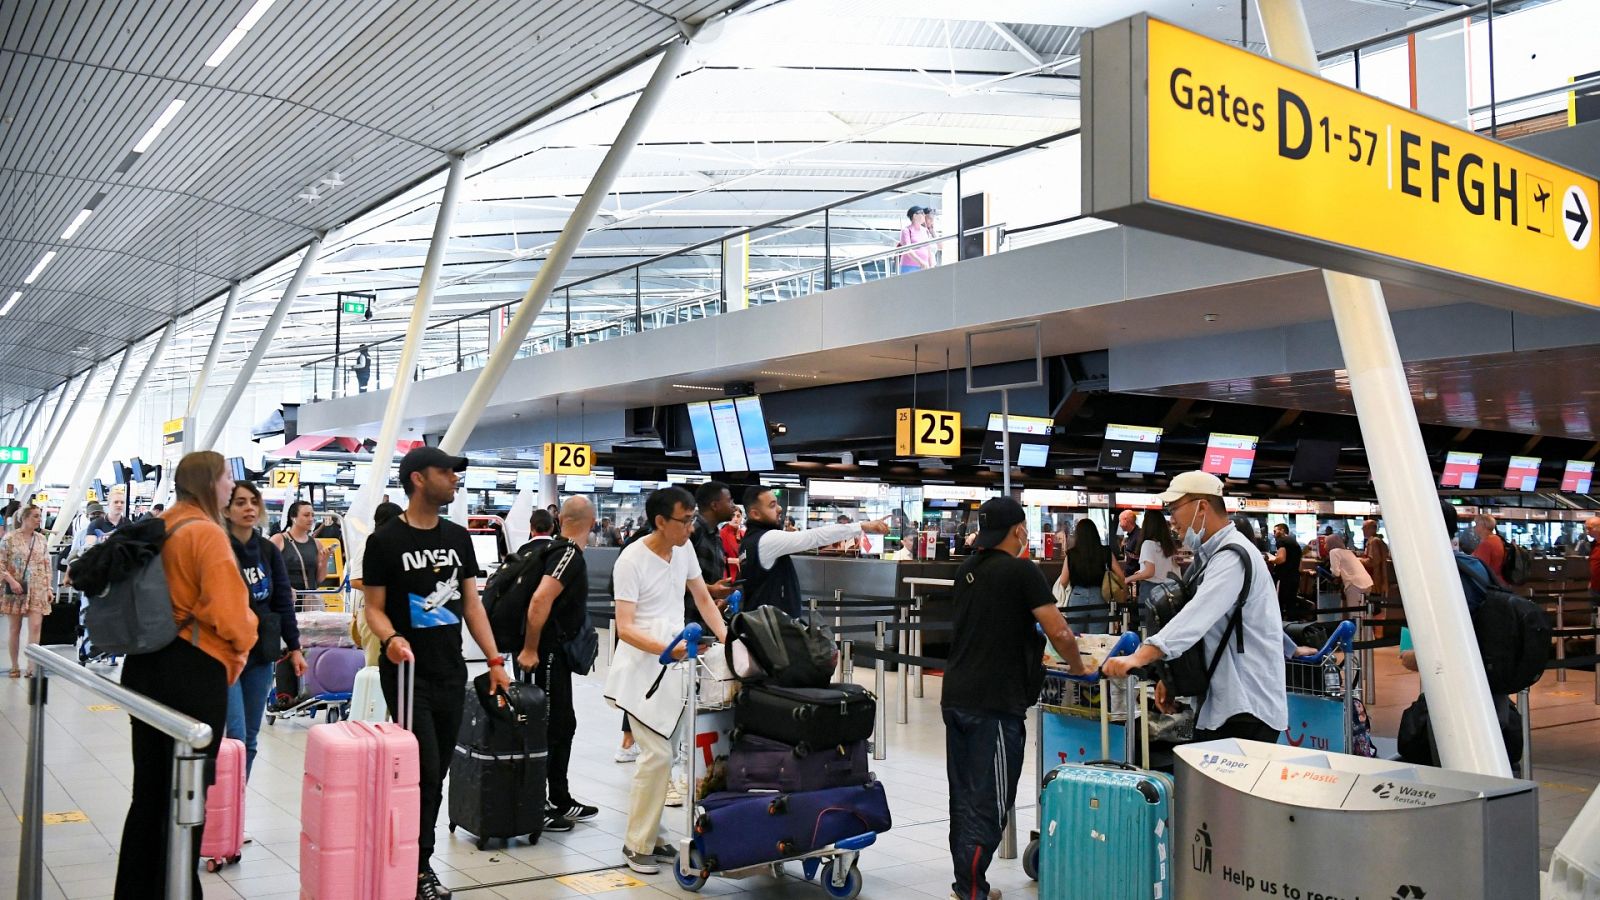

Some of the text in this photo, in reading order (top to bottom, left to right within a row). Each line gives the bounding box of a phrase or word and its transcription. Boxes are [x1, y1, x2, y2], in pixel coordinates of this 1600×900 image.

[1169, 67, 1518, 227] Gates D 1-57 EFGH
[899, 412, 908, 422] 25
[920, 413, 954, 445] 25
[559, 446, 586, 468] 26
[277, 471, 296, 484] 27
[401, 549, 463, 571] NASA
[1309, 735, 1329, 750] TUI
[1220, 758, 1249, 769] Paper
[1302, 771, 1339, 784] Plastic
[1399, 786, 1437, 800] Waste
[1222, 865, 1255, 891] Help
[1260, 879, 1278, 895] us
[1282, 883, 1301, 900] to
